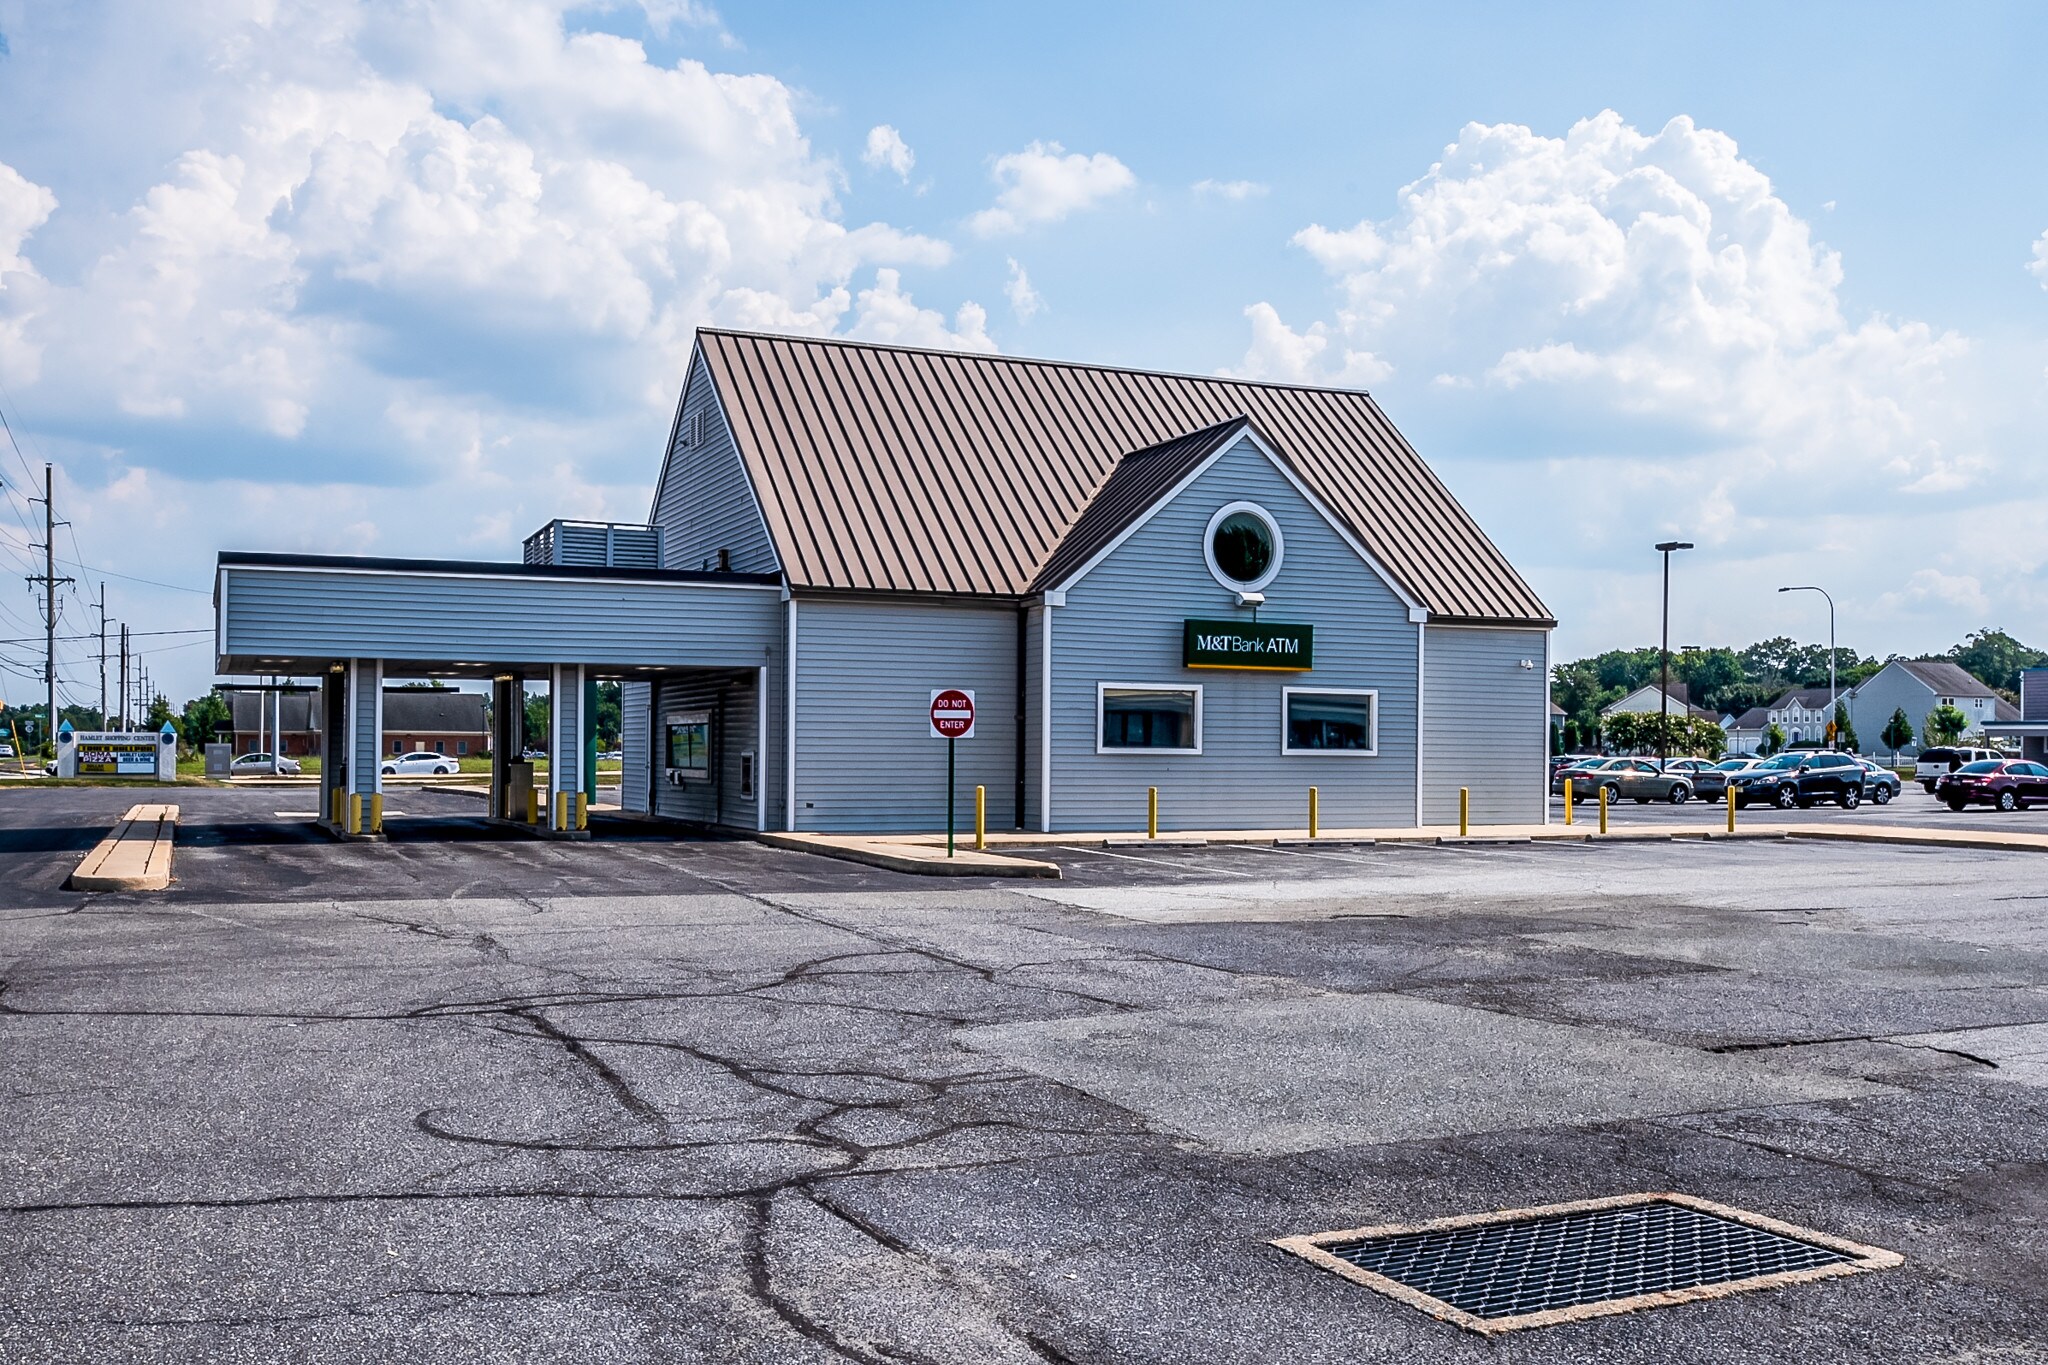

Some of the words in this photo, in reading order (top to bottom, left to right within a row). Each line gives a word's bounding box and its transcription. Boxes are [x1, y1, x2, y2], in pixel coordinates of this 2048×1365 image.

[1197, 635, 1232, 651] M&T
[1232, 636, 1264, 652] Bank
[1266, 638, 1299, 654] ATM
[938, 699, 949, 708] DO
[951, 699, 967, 708] NOT
[940, 720, 965, 729] ENTER
